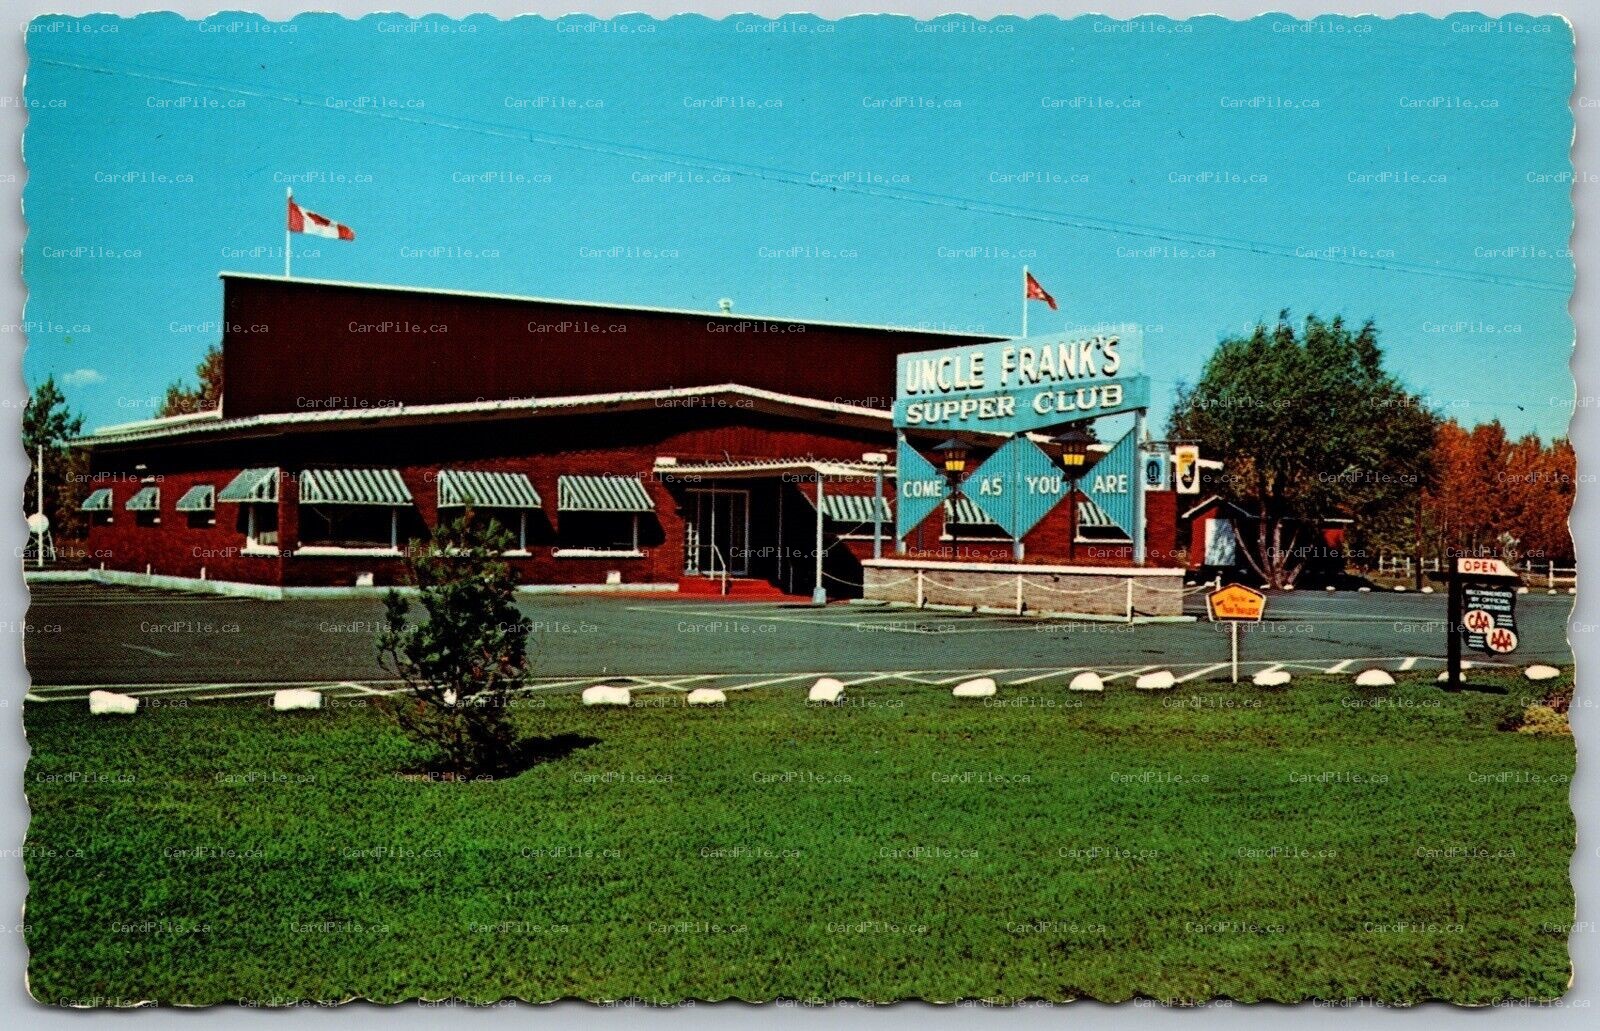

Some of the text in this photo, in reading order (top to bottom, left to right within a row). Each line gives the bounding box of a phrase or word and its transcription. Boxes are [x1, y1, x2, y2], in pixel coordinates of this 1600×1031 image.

[905, 334, 1121, 394] UNCLE FRANK'S
[906, 384, 1123, 424] SUPPER CLUB
[903, 474, 1128, 498] COME AS YOU ARE
[1463, 560, 1498, 573] OPEN
[1468, 611, 1490, 632] CAA
[1491, 629, 1512, 651] AAA
